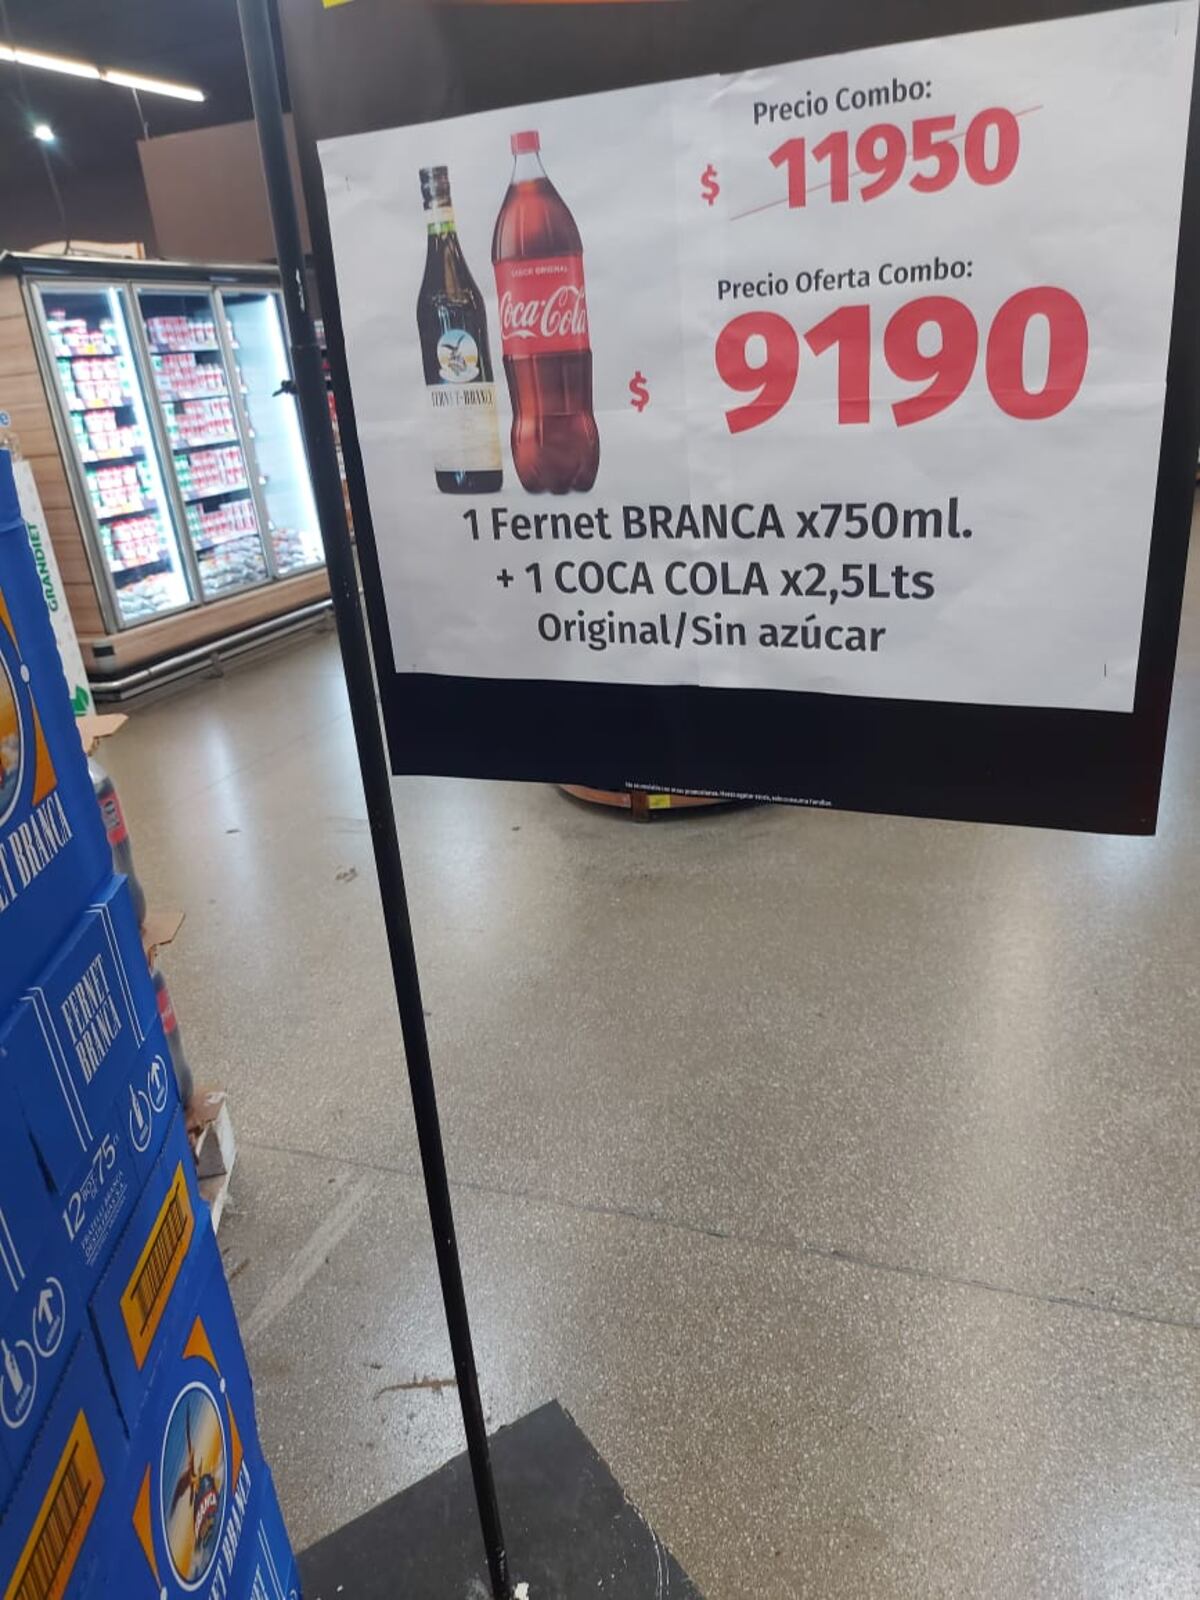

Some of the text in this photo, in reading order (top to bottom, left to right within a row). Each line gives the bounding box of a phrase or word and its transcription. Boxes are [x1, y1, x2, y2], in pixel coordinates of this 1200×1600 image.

[753, 78, 932, 125] Precio Combo:
[700, 107, 1020, 208] $ 11950
[717, 256, 974, 301] Precio Oferta Combo:
[629, 286, 1089, 433] $ 9190
[462, 496, 974, 541] 1 Fernet BRANCA x750ml.
[496, 560, 936, 606] + 1 COCA COLA x2,5Lts
[537, 610, 888, 653] Original/Sin azúcar
[8, 790, 73, 890] BRANCA
[61, 953, 110, 1046] FERNET
[75, 994, 122, 1086] BRANCA
[62, 1191, 86, 1241] 12
[92, 1132, 116, 1186] 75
[222, 1459, 251, 1577] BRANCA
